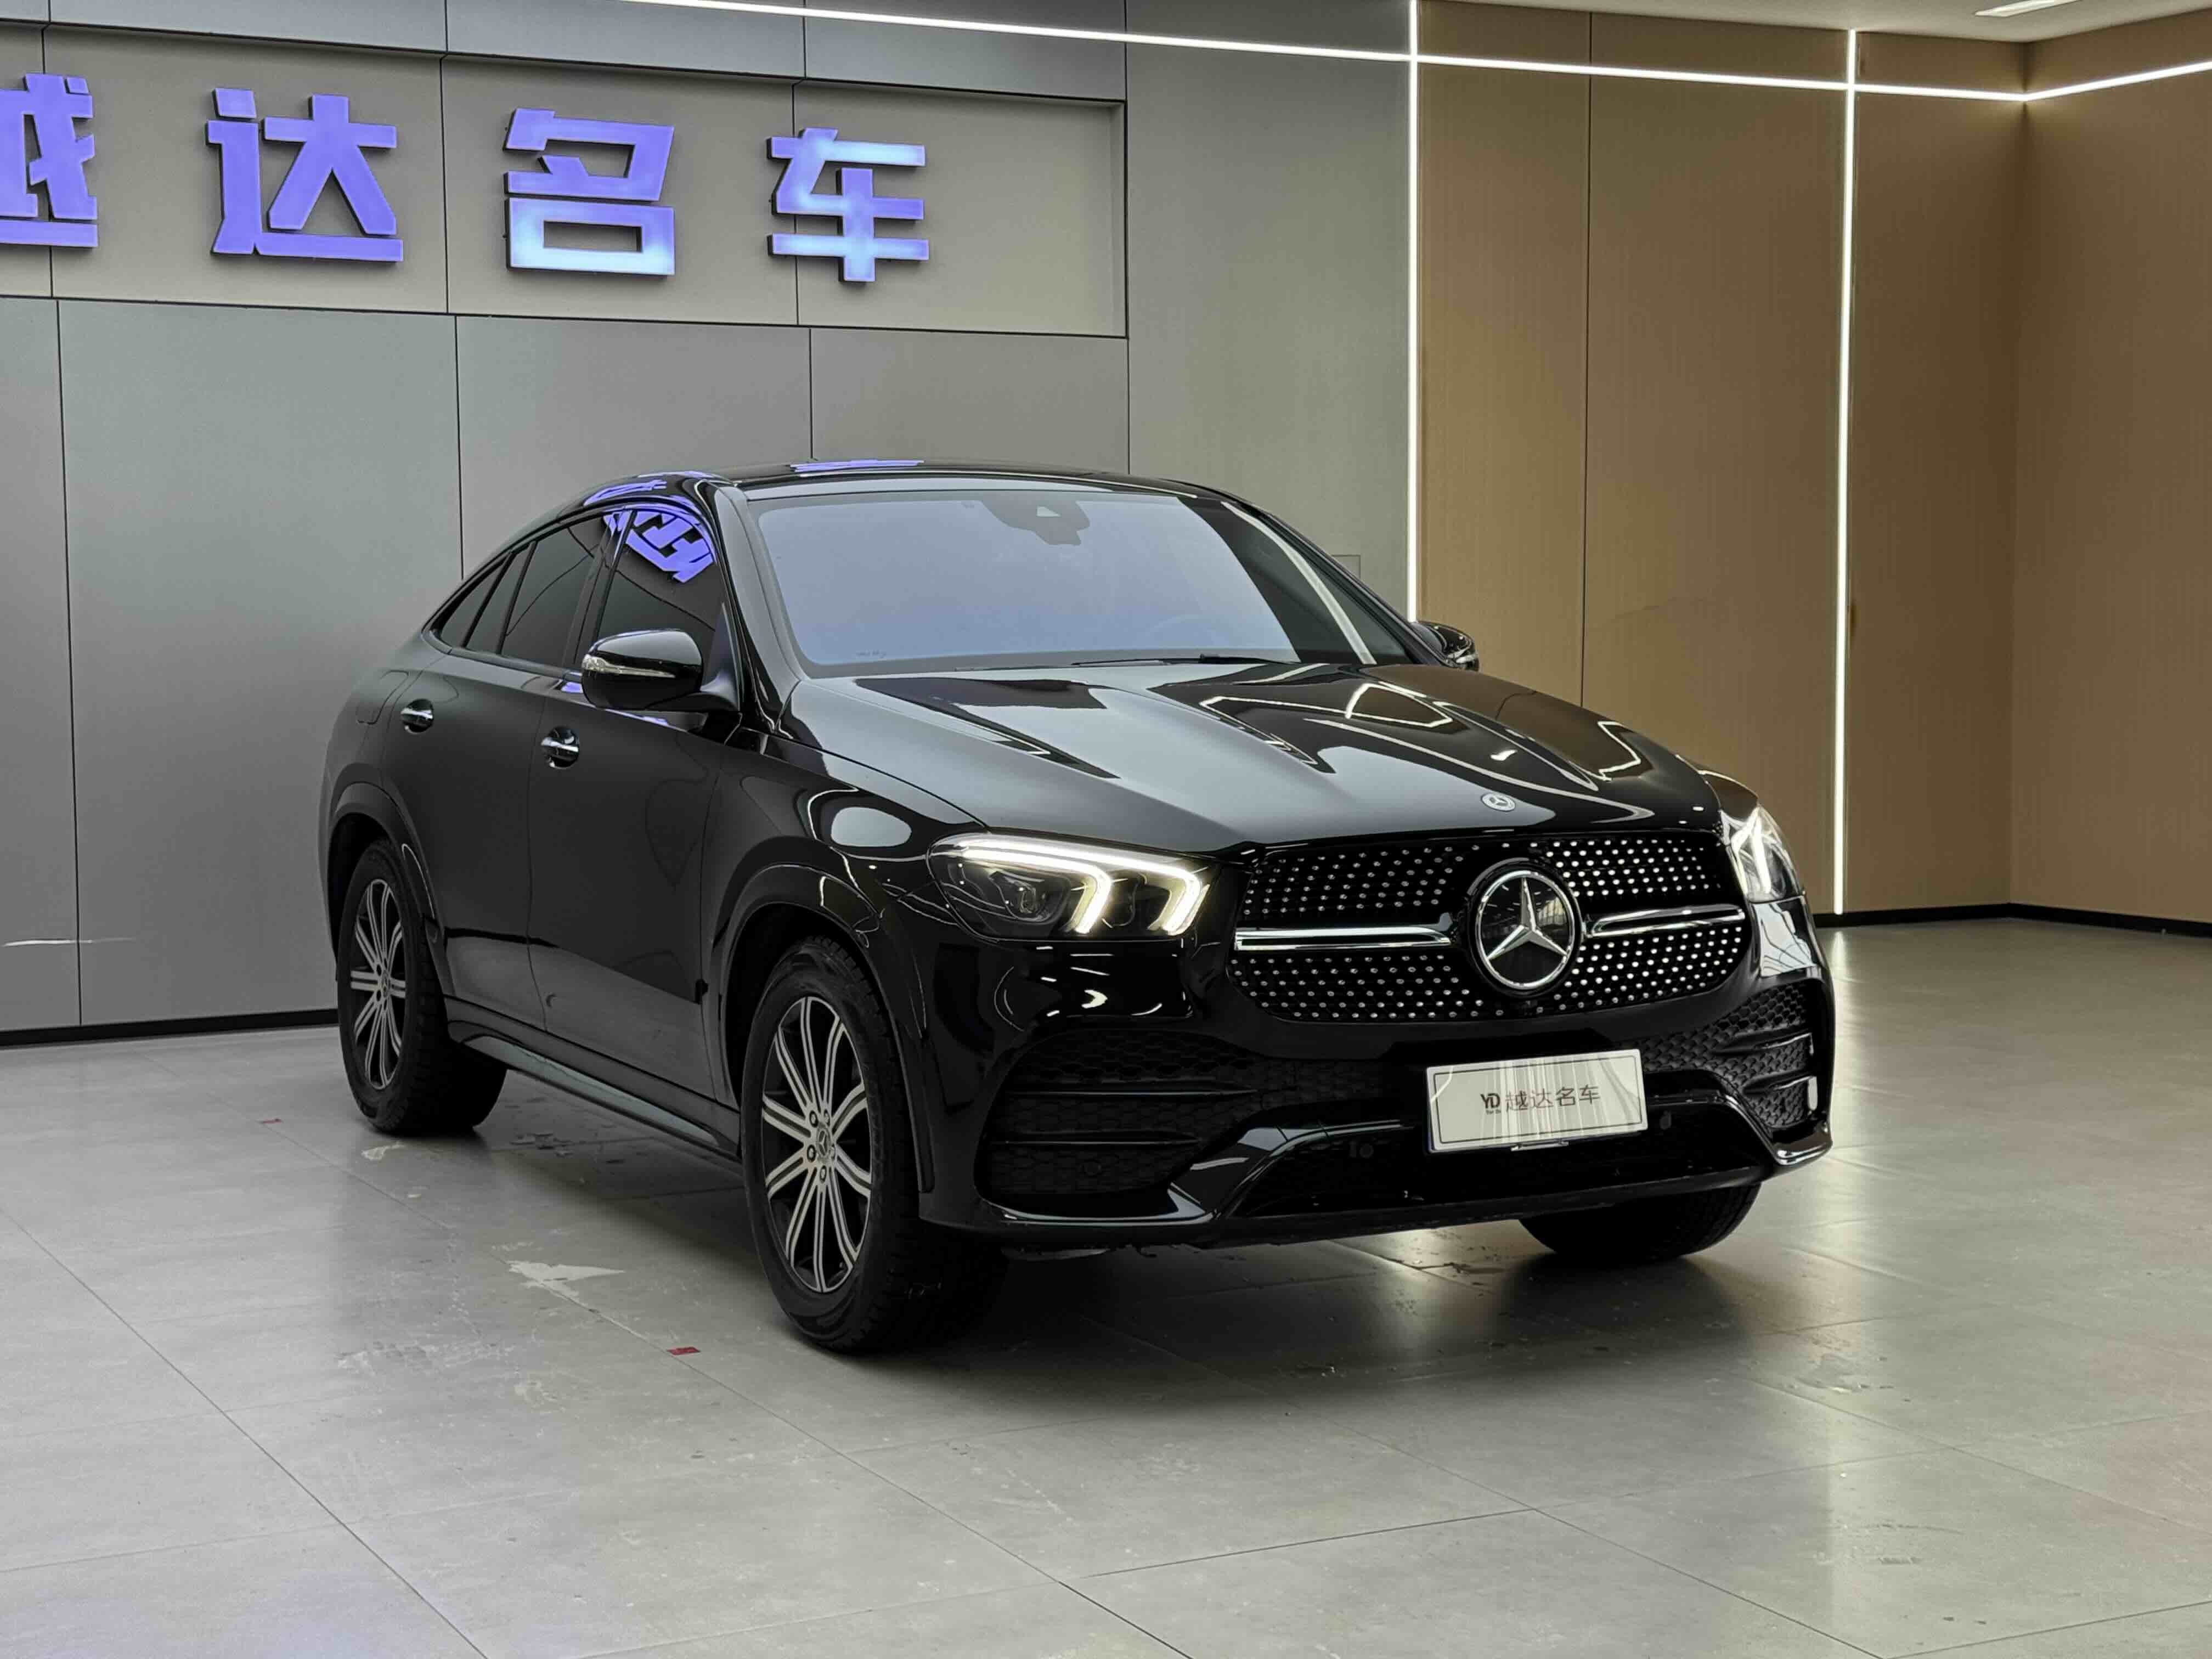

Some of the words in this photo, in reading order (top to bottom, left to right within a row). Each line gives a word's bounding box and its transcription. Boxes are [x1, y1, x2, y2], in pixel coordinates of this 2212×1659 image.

[1480, 1092, 1501, 1109] YD
[1505, 1084, 1600, 1112] 越达名车
